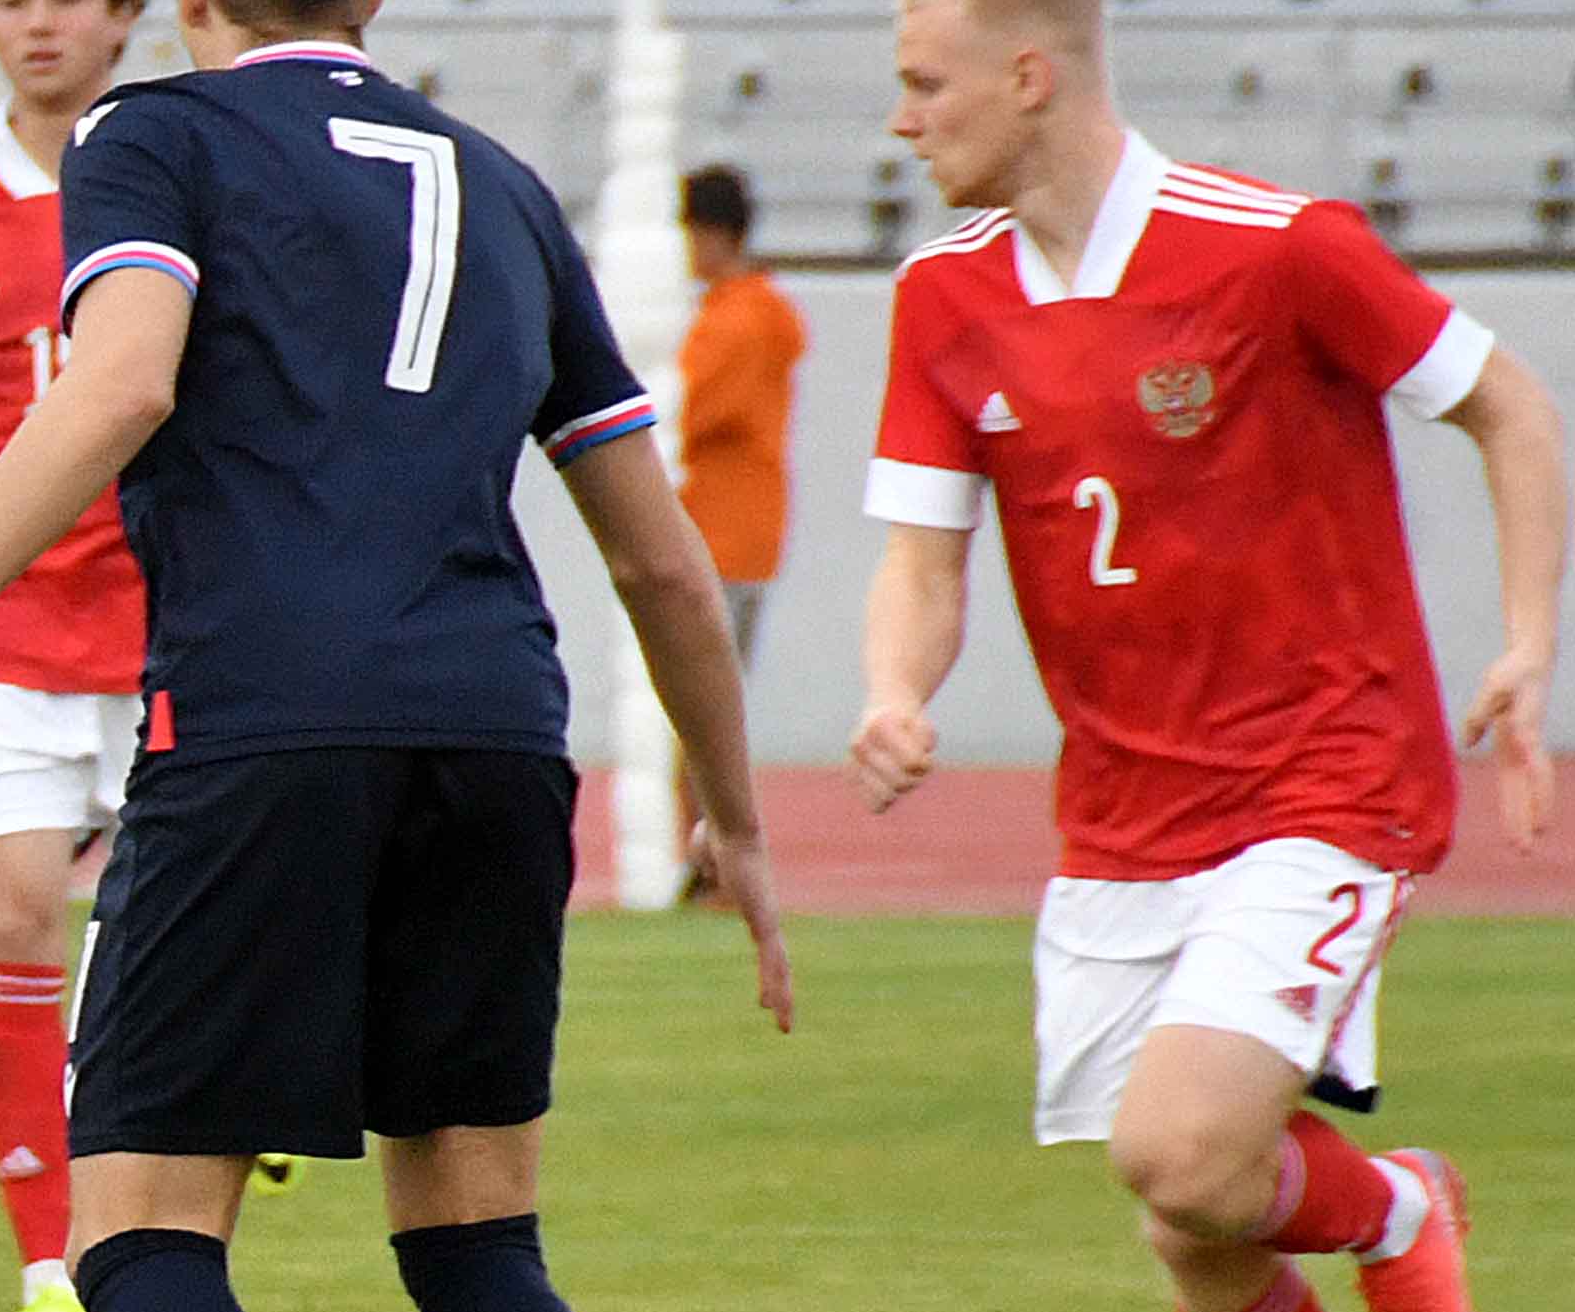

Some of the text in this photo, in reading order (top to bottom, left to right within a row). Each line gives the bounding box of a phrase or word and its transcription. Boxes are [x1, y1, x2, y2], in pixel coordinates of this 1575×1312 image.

[328, 117, 463, 395] 7
[1073, 475, 1137, 587] 2
[1306, 881, 1365, 977] 2
